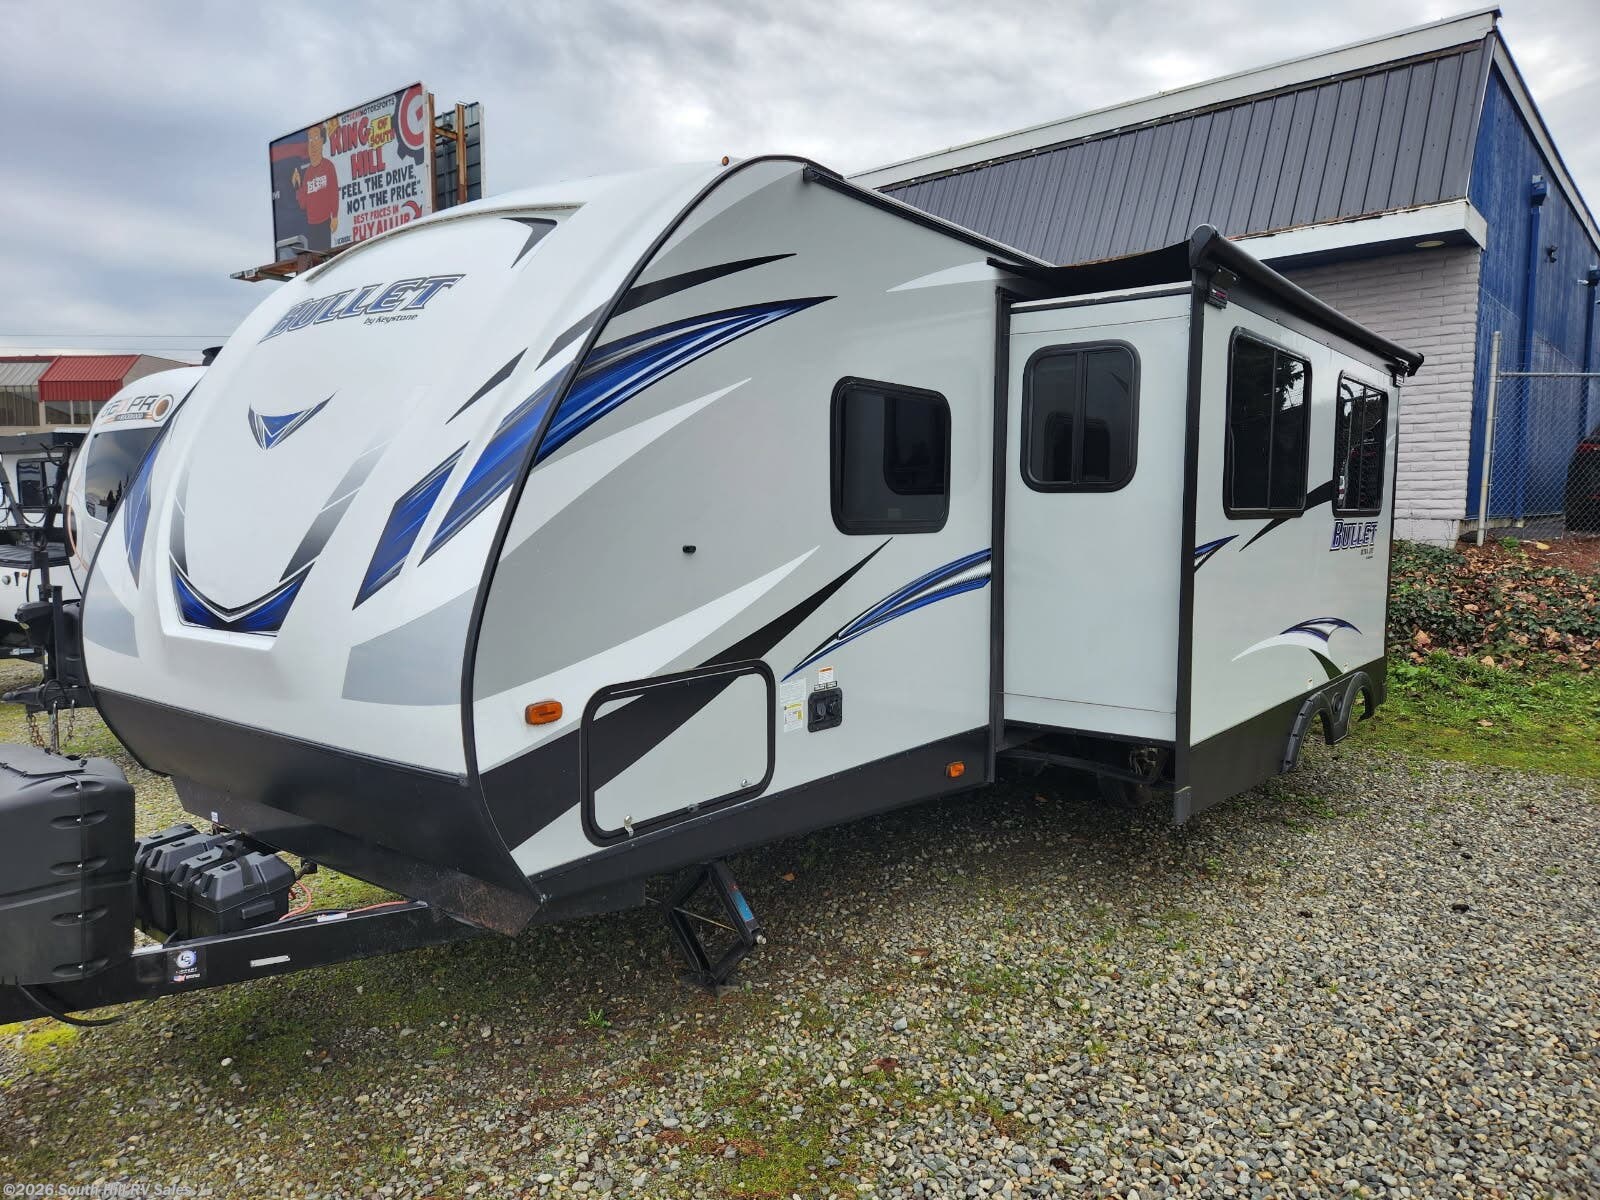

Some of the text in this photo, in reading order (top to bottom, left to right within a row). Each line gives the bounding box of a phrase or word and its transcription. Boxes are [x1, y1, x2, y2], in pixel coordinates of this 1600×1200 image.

[377, 117, 388, 130] OF
[329, 116, 371, 157] KING
[369, 127, 396, 145] SOUTH
[350, 146, 385, 181] HILL
[364, 173, 383, 193] THE
[346, 195, 367, 215] NOT
[369, 189, 388, 208] THE
[353, 204, 399, 225] BEST PRICES IN
[256, 274, 467, 345] BULLET
[363, 313, 418, 326] by Keystone
[1329, 518, 1378, 552] BULLET
